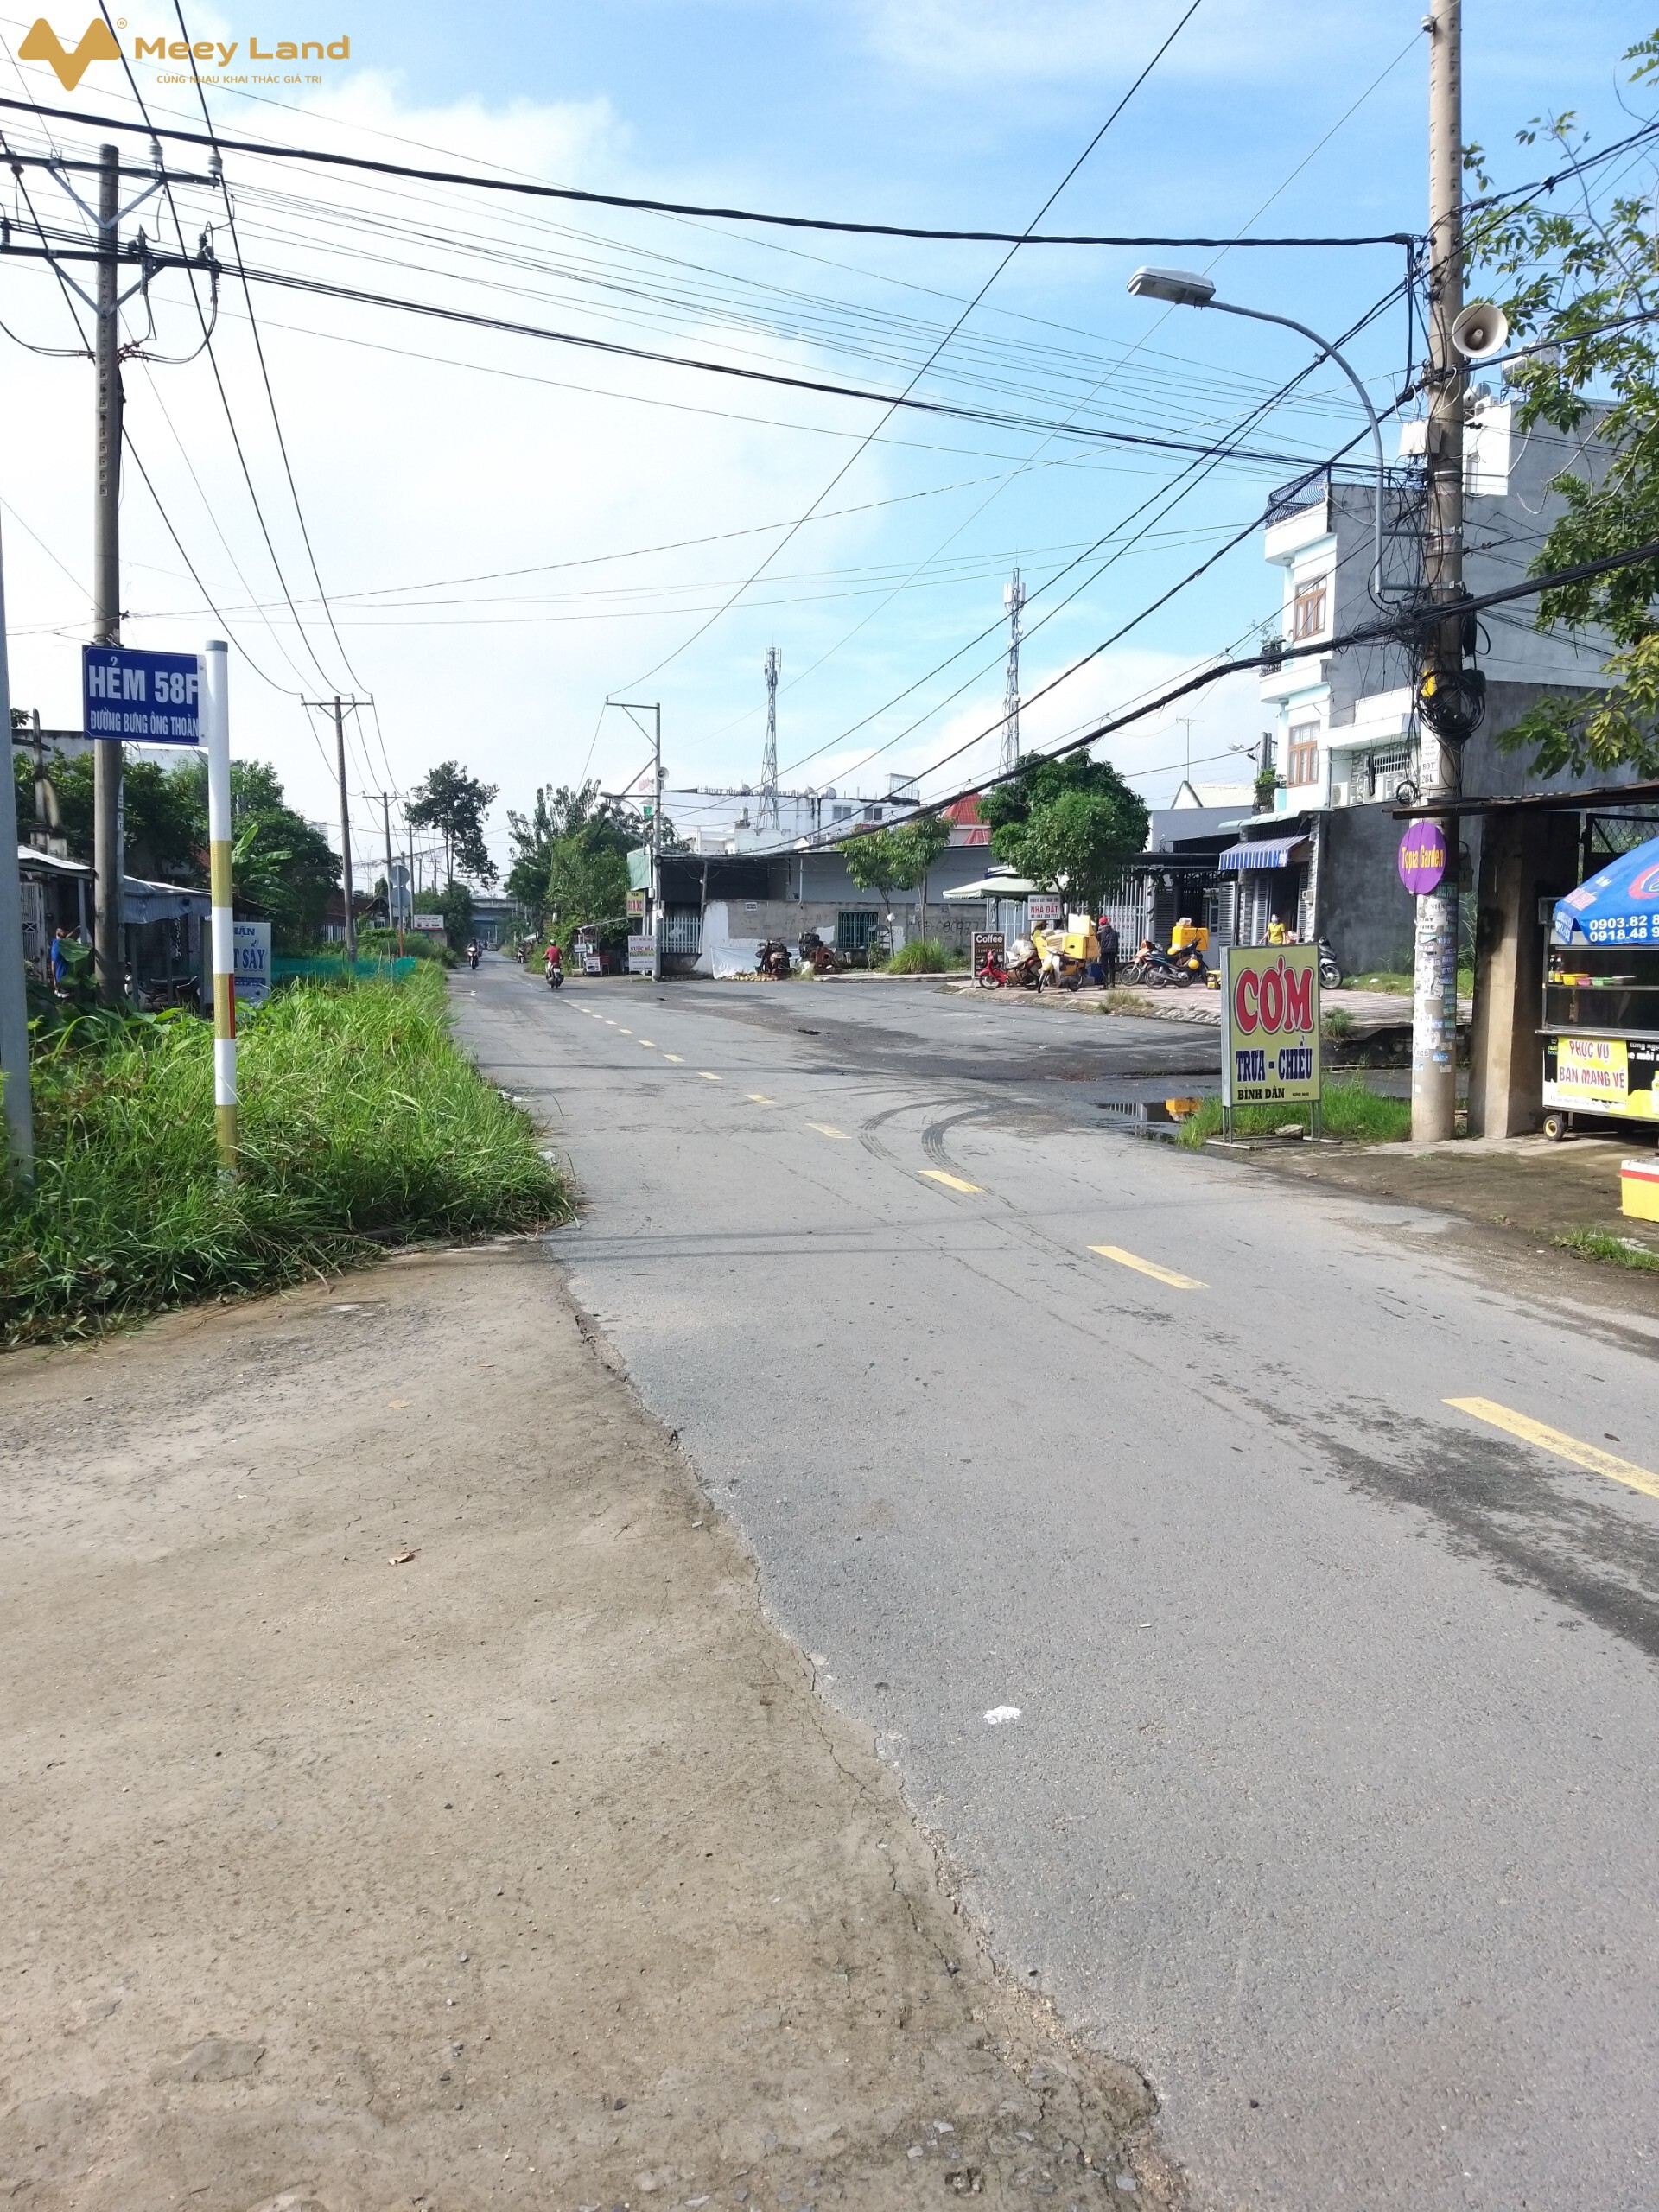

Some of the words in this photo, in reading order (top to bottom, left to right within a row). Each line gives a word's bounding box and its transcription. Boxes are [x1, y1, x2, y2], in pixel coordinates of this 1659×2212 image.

[88, 656, 145, 702] HẺM
[154, 671, 199, 705] 58F
[91, 707, 121, 732] ĐƯỜNG
[150, 711, 168, 735] ÔNG
[170, 713, 199, 737] THOÀN
[1420, 844, 1444, 868] Garden
[1030, 904, 1044, 914] NHÀ
[1046, 903, 1059, 914] ĐẤT
[1589, 915, 1648, 931] 0903.82
[976, 934, 1003, 943] Coffee
[1589, 927, 1648, 943] 0918.48
[242, 940, 265, 969] SẤY
[1235, 955, 1314, 1034] CƠM
[1236, 1049, 1266, 1082] TRƯA
[1278, 1036, 1313, 1080] CHIỀU
[1568, 1040, 1593, 1061] PHỤC
[1597, 1043, 1610, 1063] VỤ
[1581, 1068, 1611, 1088] MANG
[1237, 1086, 1262, 1101] BÌNH
[1265, 1085, 1285, 1099] DÂN
